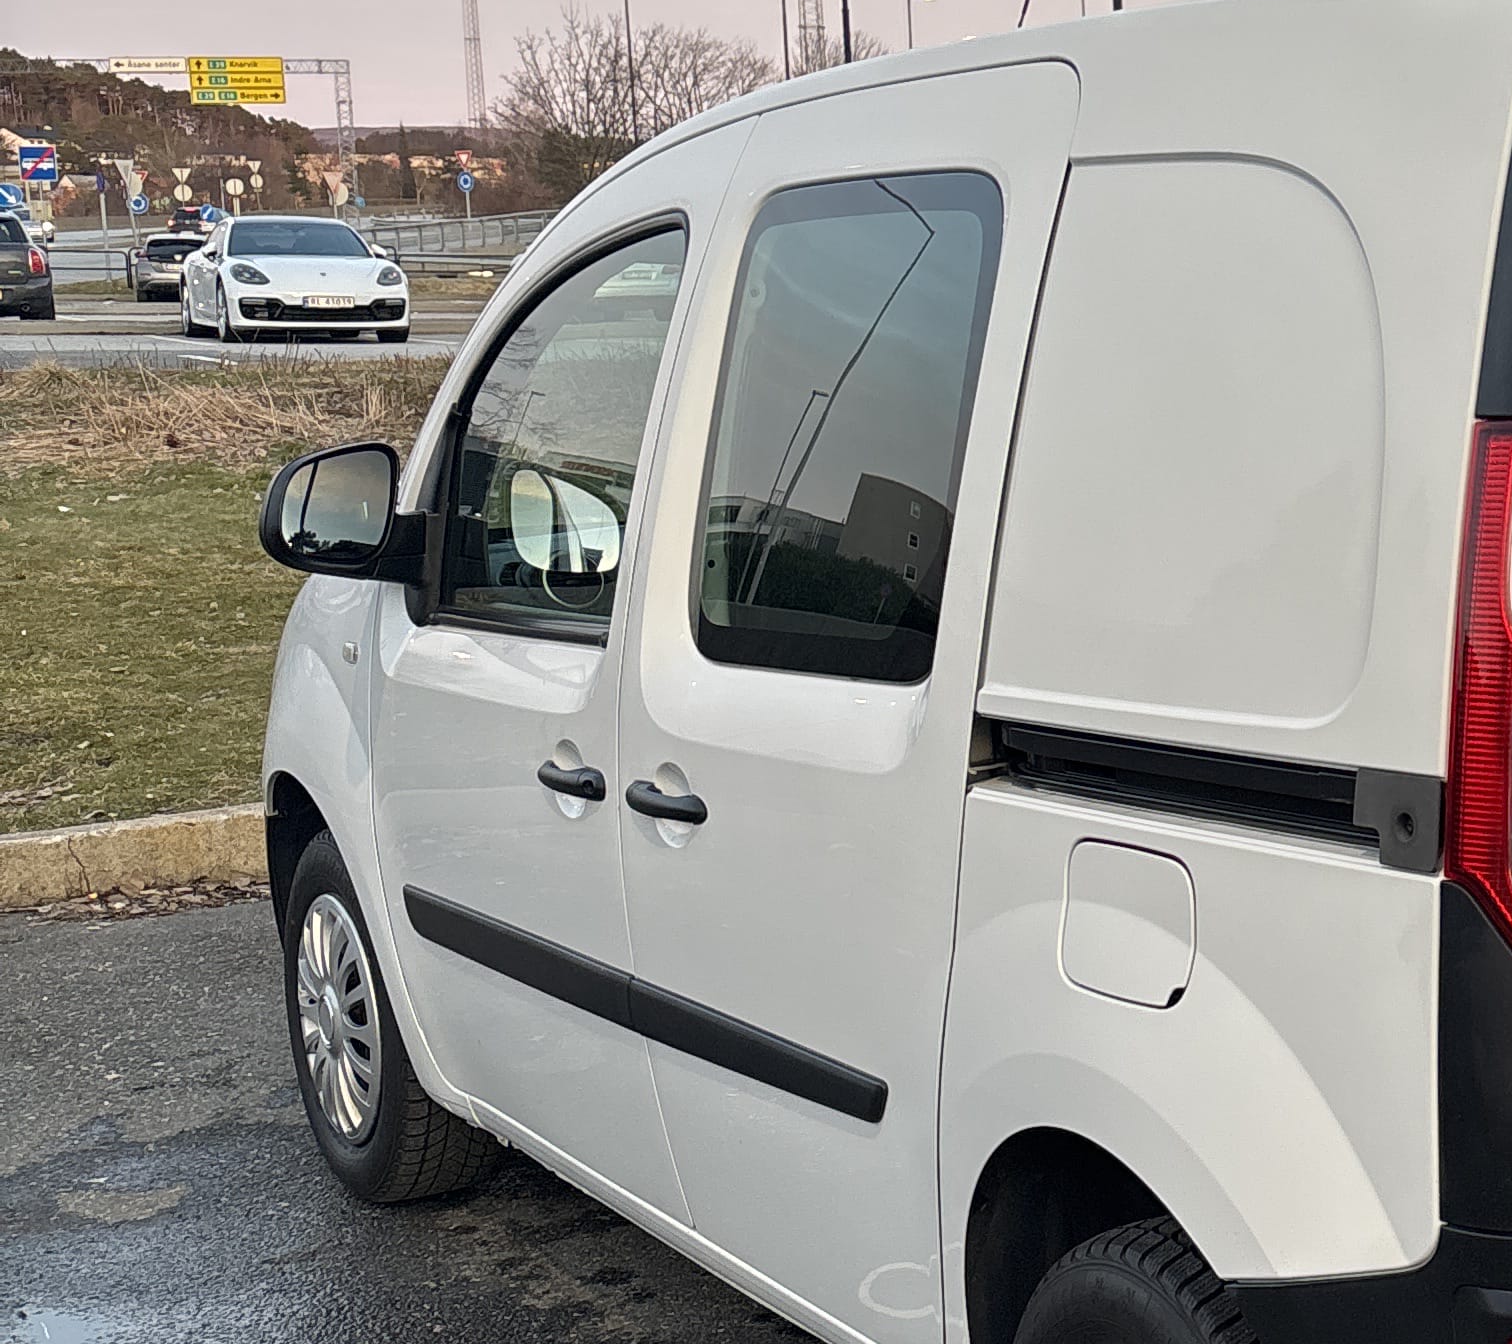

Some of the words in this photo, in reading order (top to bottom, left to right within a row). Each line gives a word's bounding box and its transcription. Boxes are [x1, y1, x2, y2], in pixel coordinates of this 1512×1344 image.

[229, 60, 258, 68] Knarvik
[230, 76, 251, 84] Indre
[253, 76, 272, 84] Arna
[240, 91, 269, 101] Bergen
